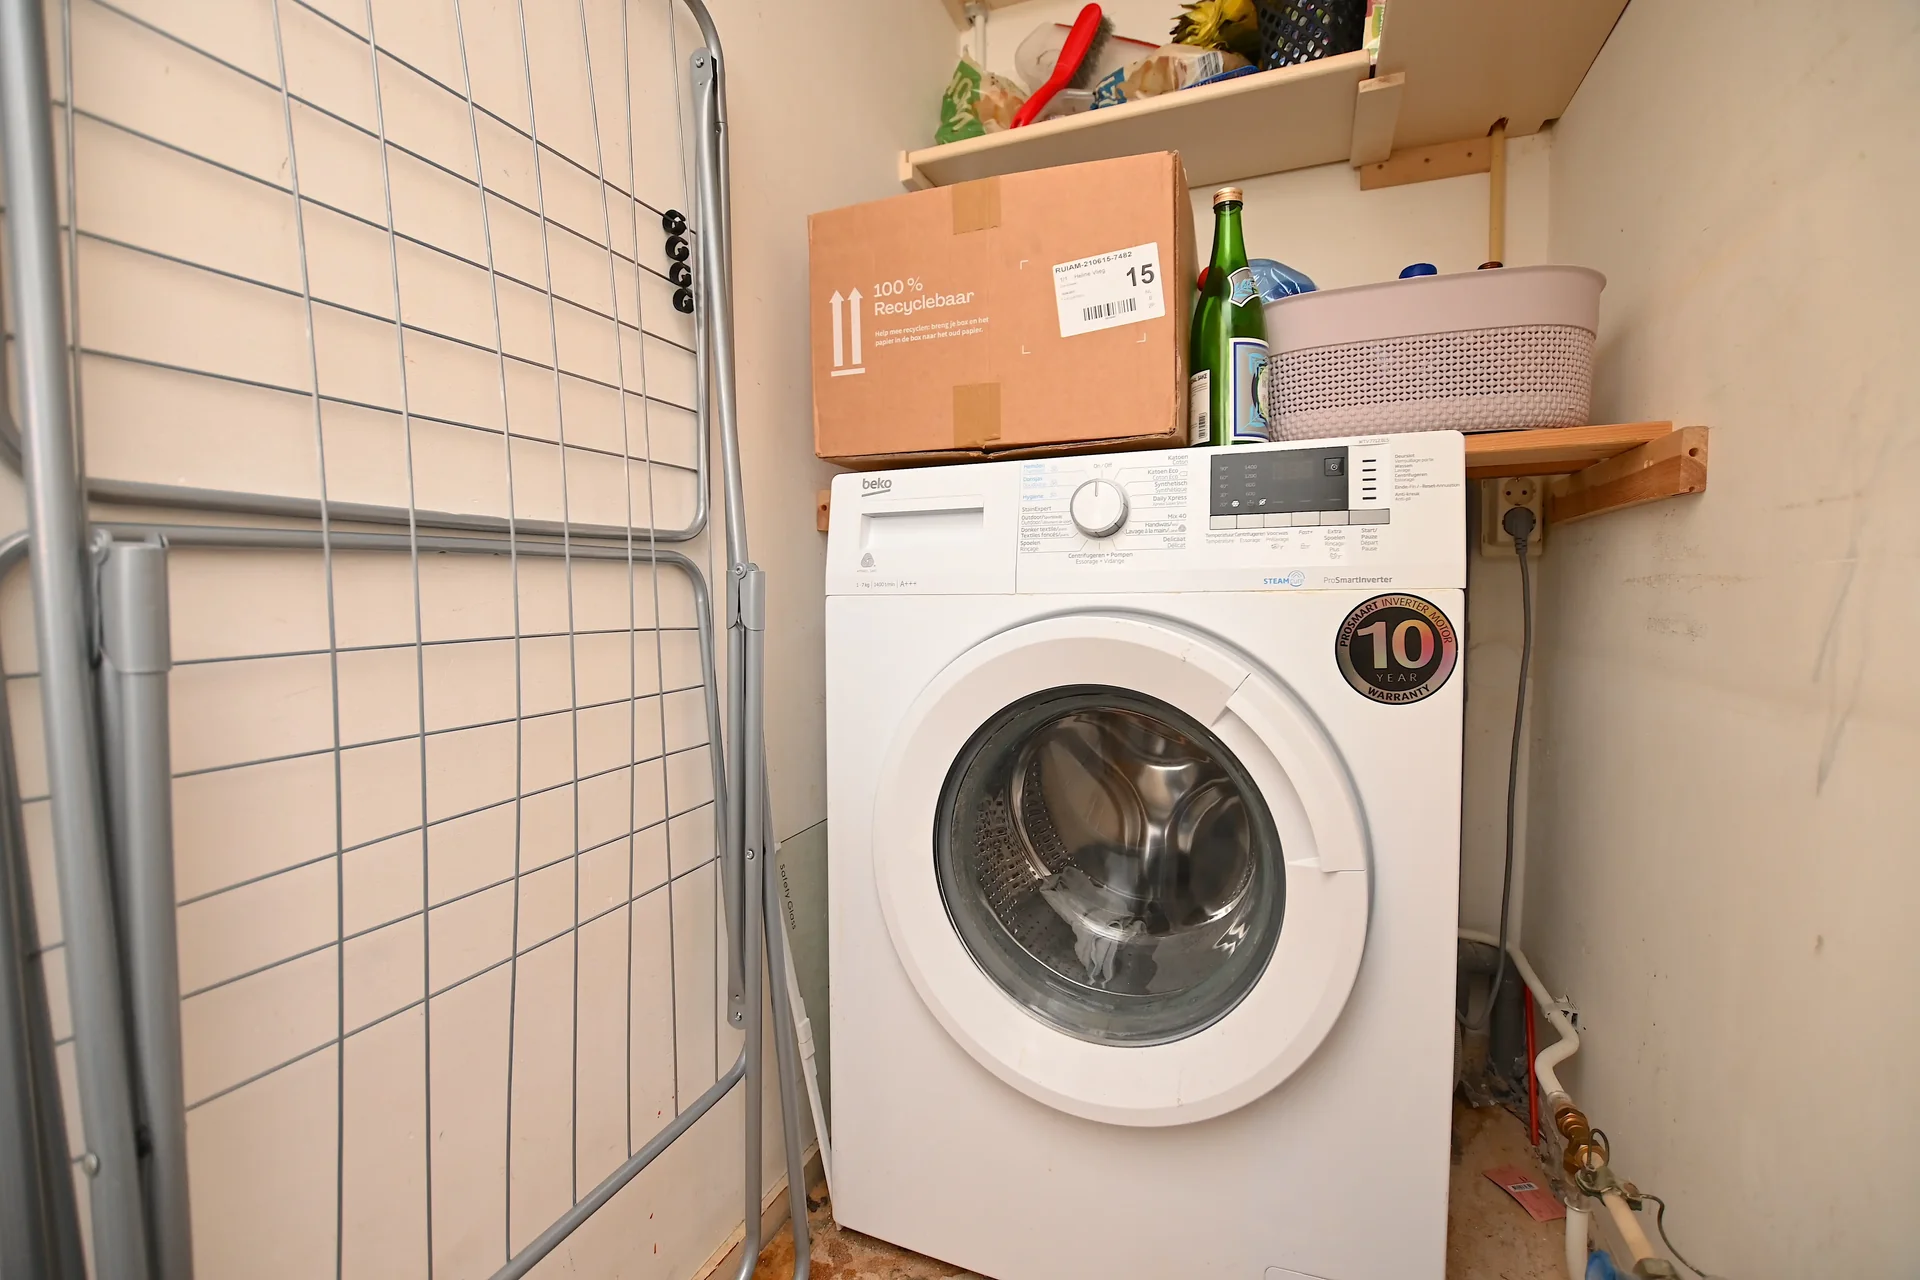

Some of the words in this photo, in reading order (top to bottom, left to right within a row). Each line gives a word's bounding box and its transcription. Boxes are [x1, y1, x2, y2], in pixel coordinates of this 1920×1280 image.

[1126, 263, 1155, 287] 15
[873, 279, 904, 298] 100
[907, 276, 923, 293] %
[874, 291, 975, 316] Recyclebaar
[875, 330, 889, 338] Help
[903, 325, 930, 334] recyclen:
[931, 321, 949, 330] breng
[949, 321, 956, 329] je
[875, 339, 894, 347] papier
[901, 335, 910, 343] de
[910, 333, 922, 341] box
[937, 330, 948, 338] het
[948, 328, 961, 337] oud
[961, 326, 984, 336] papier.
[862, 477, 892, 490] beko
[1154, 480, 1188, 488] Synthetisch
[899, 580, 917, 588] A+++
[1323, 576, 1393, 584] ProSmartInverter
[1340, 601, 1379, 647] PROSMART
[1381, 597, 1430, 614] INVERTER
[1428, 611, 1453, 644] MOTOR
[1357, 619, 1435, 669] 10
[1376, 673, 1417, 682] YEAR
[1367, 683, 1430, 701] WARRANTY
[787, 900, 797, 930] Glass
